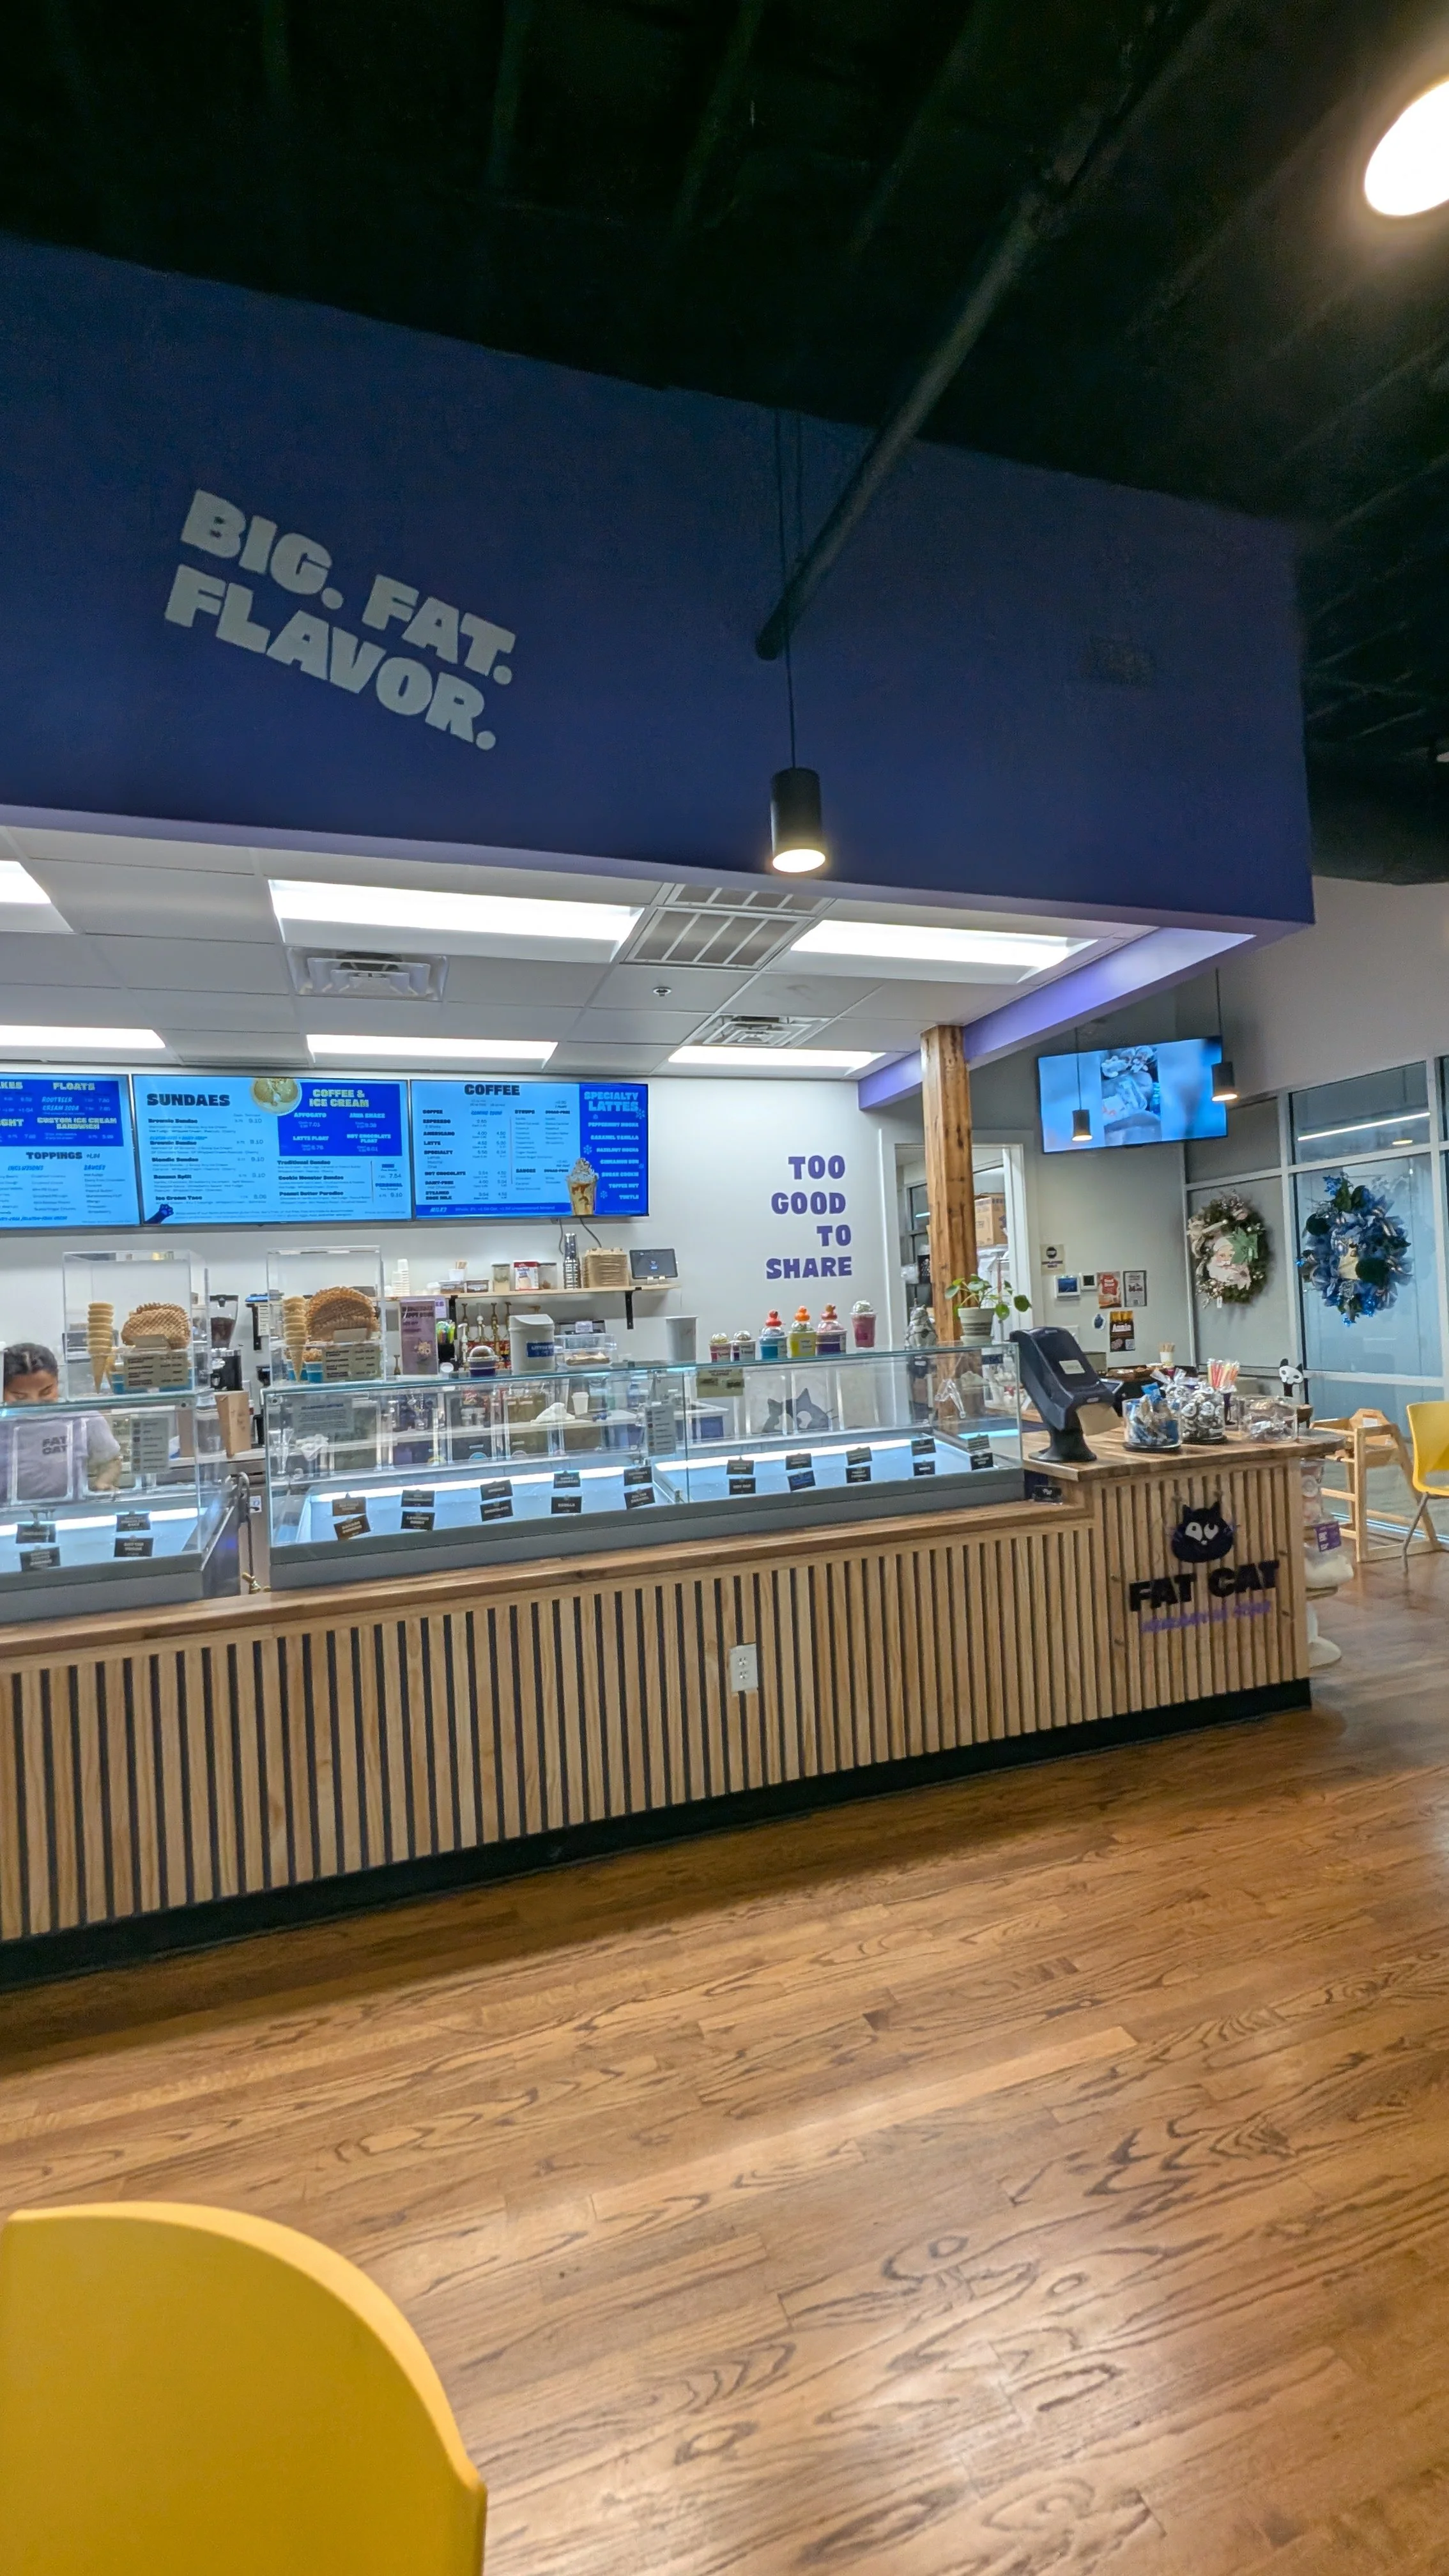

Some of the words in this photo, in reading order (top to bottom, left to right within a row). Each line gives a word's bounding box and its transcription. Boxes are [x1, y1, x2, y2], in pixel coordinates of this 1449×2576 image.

[180, 488, 343, 610] BIG.
[362, 574, 516, 685] FAT.
[164, 564, 496, 751] FLAVOR.
[147, 1093, 231, 1107] SUNDAES
[464, 1084, 520, 1096] COFFEE
[584, 1091, 638, 1100] SPECIALTY
[309, 1098, 328, 1107] ICE
[330, 1098, 369, 1107] CREAM
[588, 1101, 639, 1112] LATTES
[788, 1154, 845, 1179] TOO
[771, 1192, 846, 1215] GOOD
[816, 1224, 852, 1246] TO
[766, 1256, 852, 1280] SHARE
[1130, 1572, 1197, 1612] FAT
[1208, 1560, 1280, 1597] CAT
